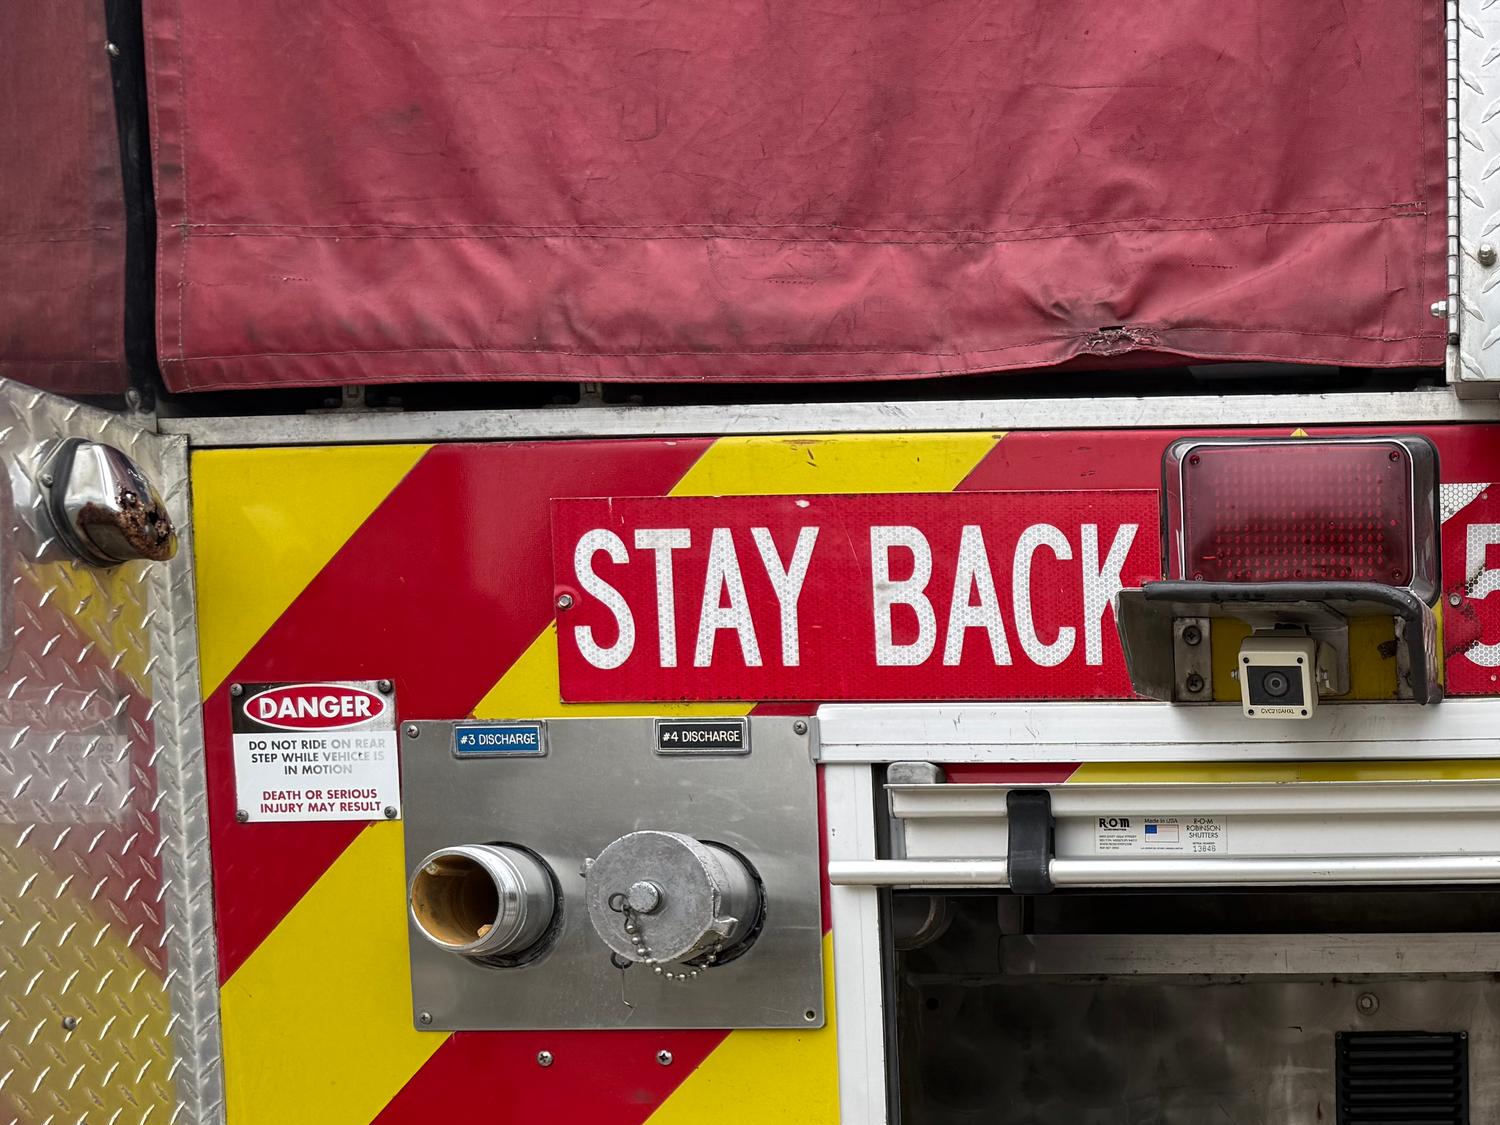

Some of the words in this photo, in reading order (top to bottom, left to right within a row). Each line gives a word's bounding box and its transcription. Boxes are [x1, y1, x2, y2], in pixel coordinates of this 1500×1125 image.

[573, 526, 819, 669] STAY
[869, 523, 1139, 667] BACK
[259, 695, 373, 719] DANGER
[460, 734, 475, 745] #3
[478, 733, 536, 745] DISCHARGE
[662, 731, 679, 742] #4
[682, 730, 740, 742] DISCHARGE
[249, 740, 267, 751] DO
[271, 740, 297, 750] NOT
[301, 739, 327, 750] RIDE
[331, 739, 351, 749] ON
[355, 738, 385, 749] REAR
[251, 753, 278, 763] STEP
[281, 752, 318, 762] WHILE
[322, 751, 370, 762] VEHICLE
[374, 751, 385, 761] IS
[284, 765, 297, 775] IN
[302, 764, 352, 775] MOTION
[263, 790, 301, 801] DEATH
[305, 789, 323, 799] OR
[327, 789, 377, 799] SERIOUS
[260, 803, 303, 813] INJURY
[308, 802, 335, 812] MAY
[340, 801, 381, 811] RESULT
[1186, 824, 1221, 832] ROBINSON
[1189, 831, 1219, 839] SHUTTERS
